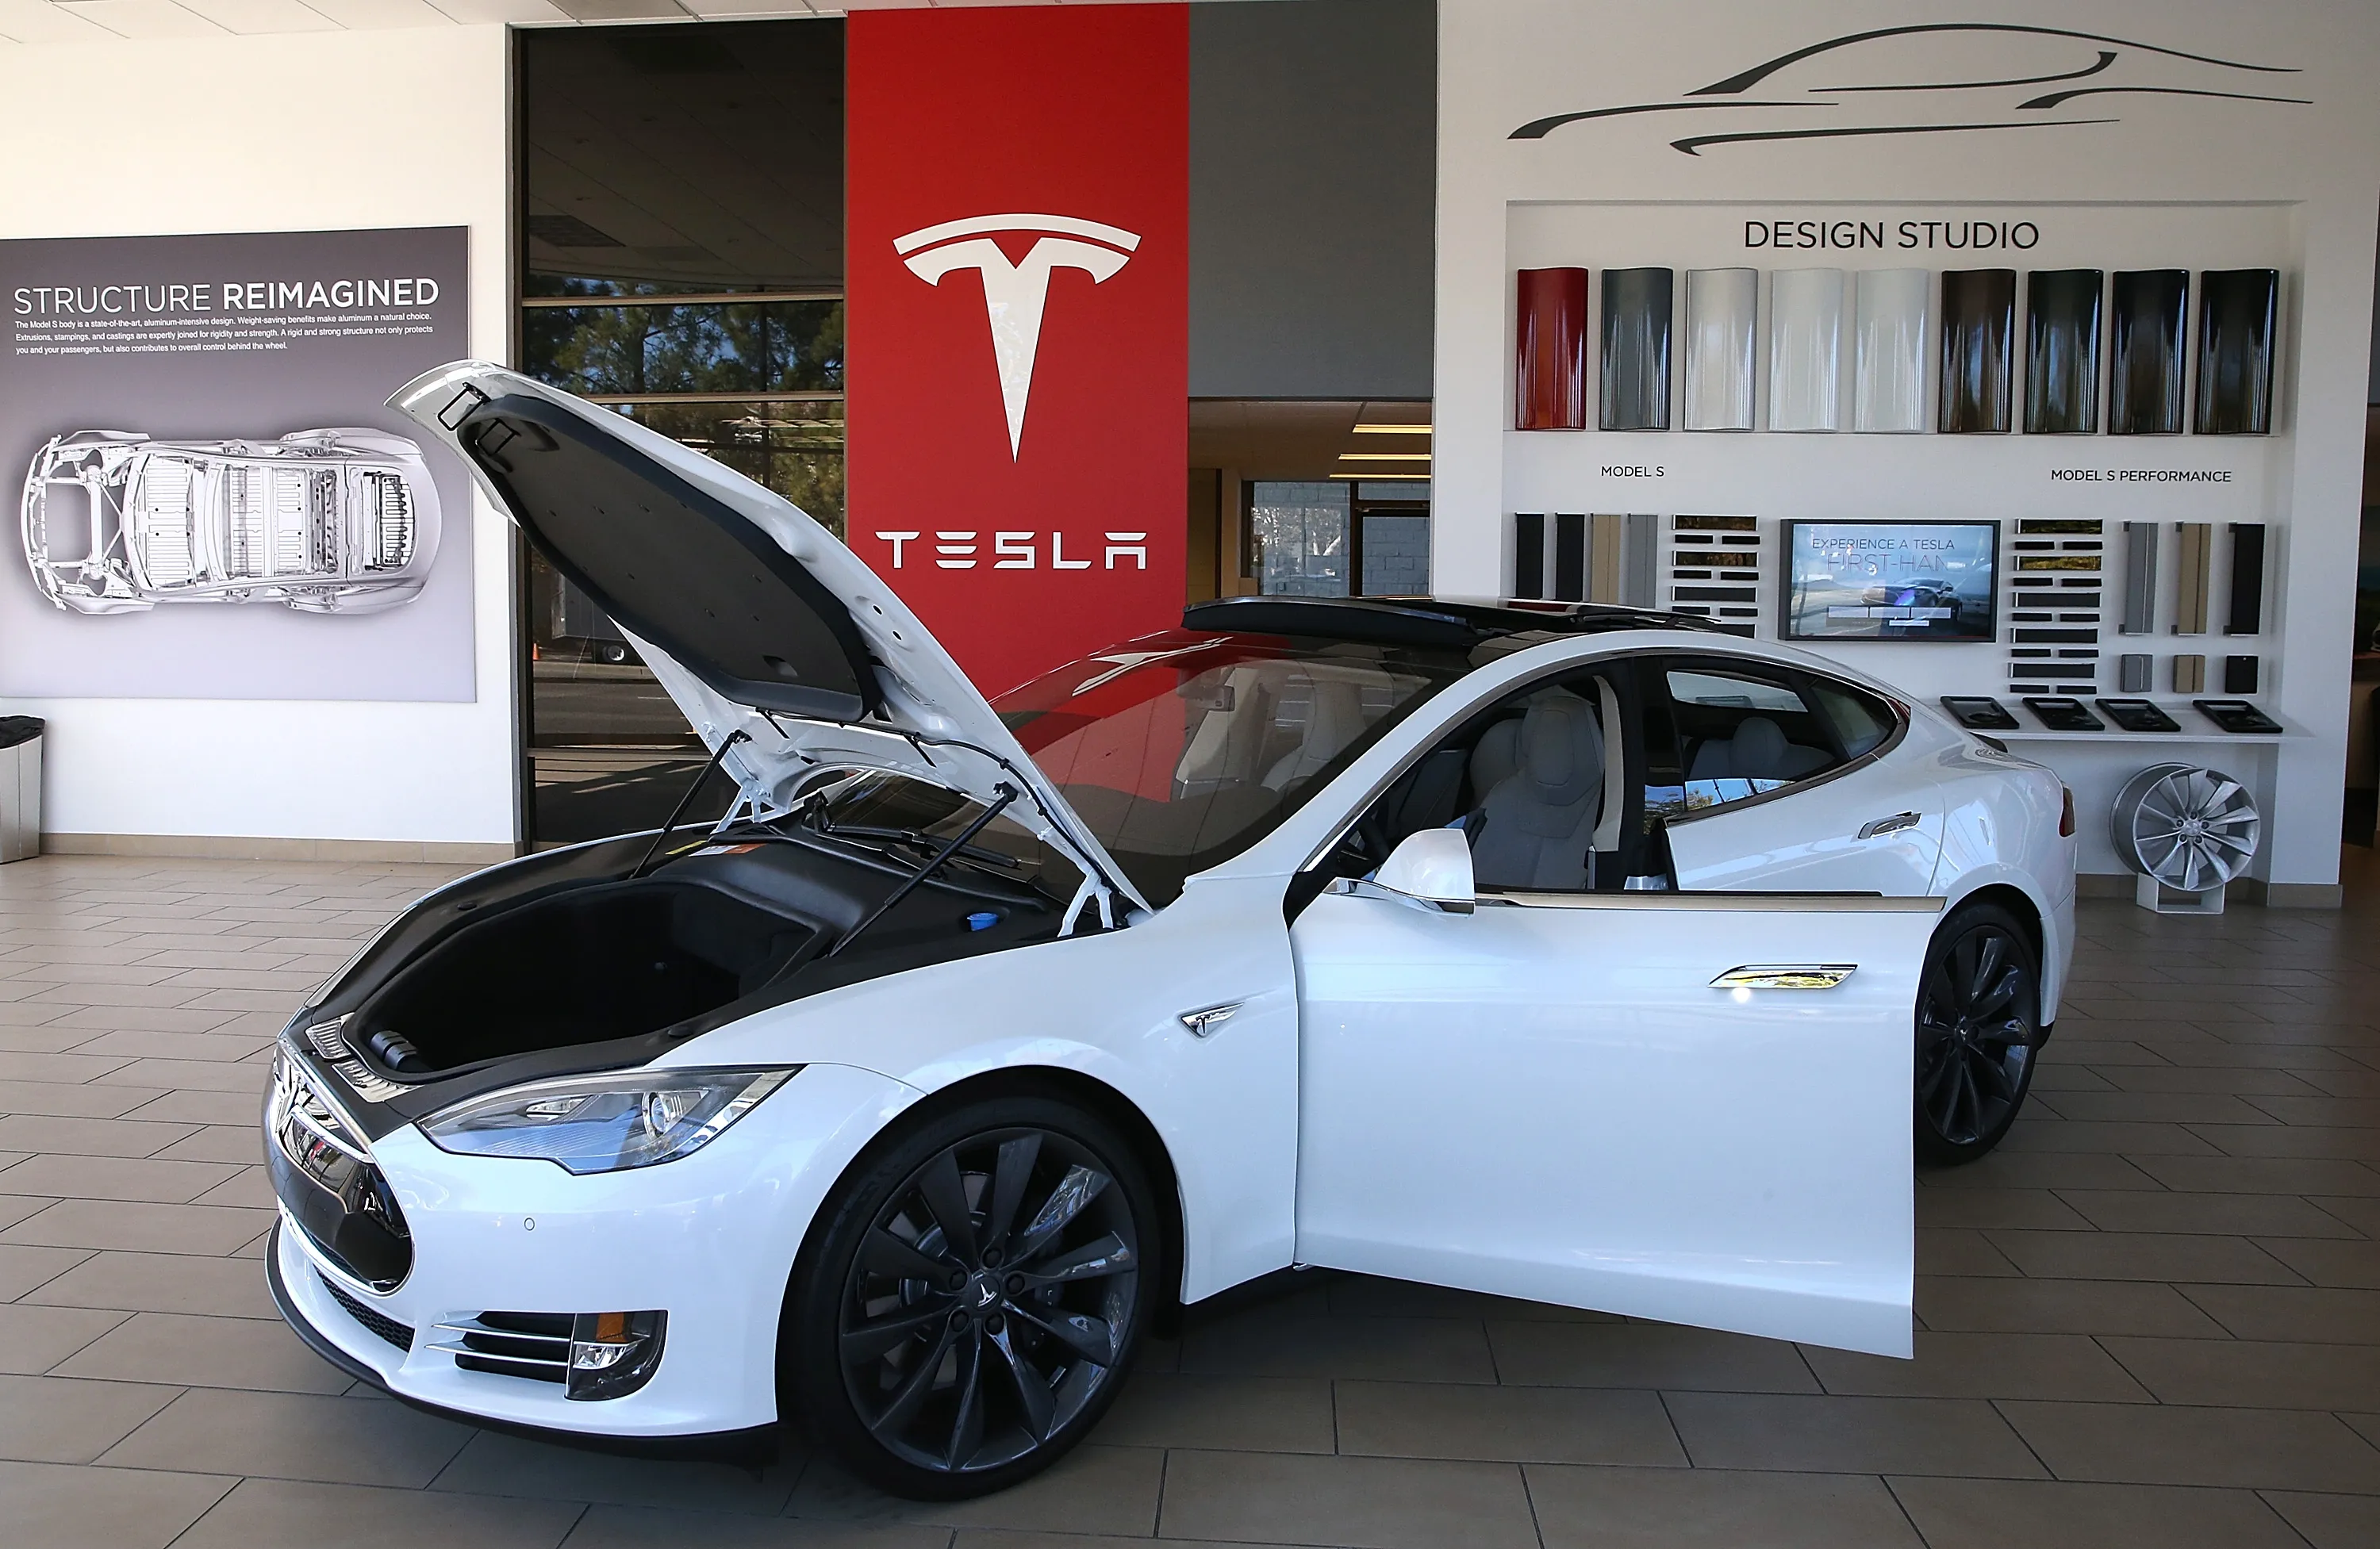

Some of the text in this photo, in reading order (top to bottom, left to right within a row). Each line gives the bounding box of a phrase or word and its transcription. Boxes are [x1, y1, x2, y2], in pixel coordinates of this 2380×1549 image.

[1745, 221, 2039, 249] DESIGN STUDIO
[13, 278, 440, 315] STRUCTURE REIMAGINED
[59, 320, 76, 329] body
[90, 320, 143, 328] state-of-the-art,
[144, 318, 209, 327] aluminum-intensive
[211, 317, 236, 327] design.
[237, 316, 286, 325] Weight-saving
[15, 333, 52, 342] Extrusions,
[54, 332, 90, 342] stampings,
[106, 332, 135, 341] castings
[148, 331, 176, 340] expertly
[176, 330, 198, 340] joined
[209, 330, 232, 339] rigidity
[249, 329, 279, 339] strength.
[287, 328, 302, 338] rigid
[319, 328, 341, 337] strong
[387, 326, 403, 335] only
[404, 326, 433, 335] protects
[44, 347, 60, 355] your
[227, 342, 251, 351] behind
[265, 341, 288, 350] wheel.
[1601, 466, 1664, 477] MODEL S
[2051, 470, 2232, 482] MODEL S PERFORMANCE
[874, 531, 1147, 569] TESLA
[1812, 539, 1955, 550] EXPERIENCE A TESLA
